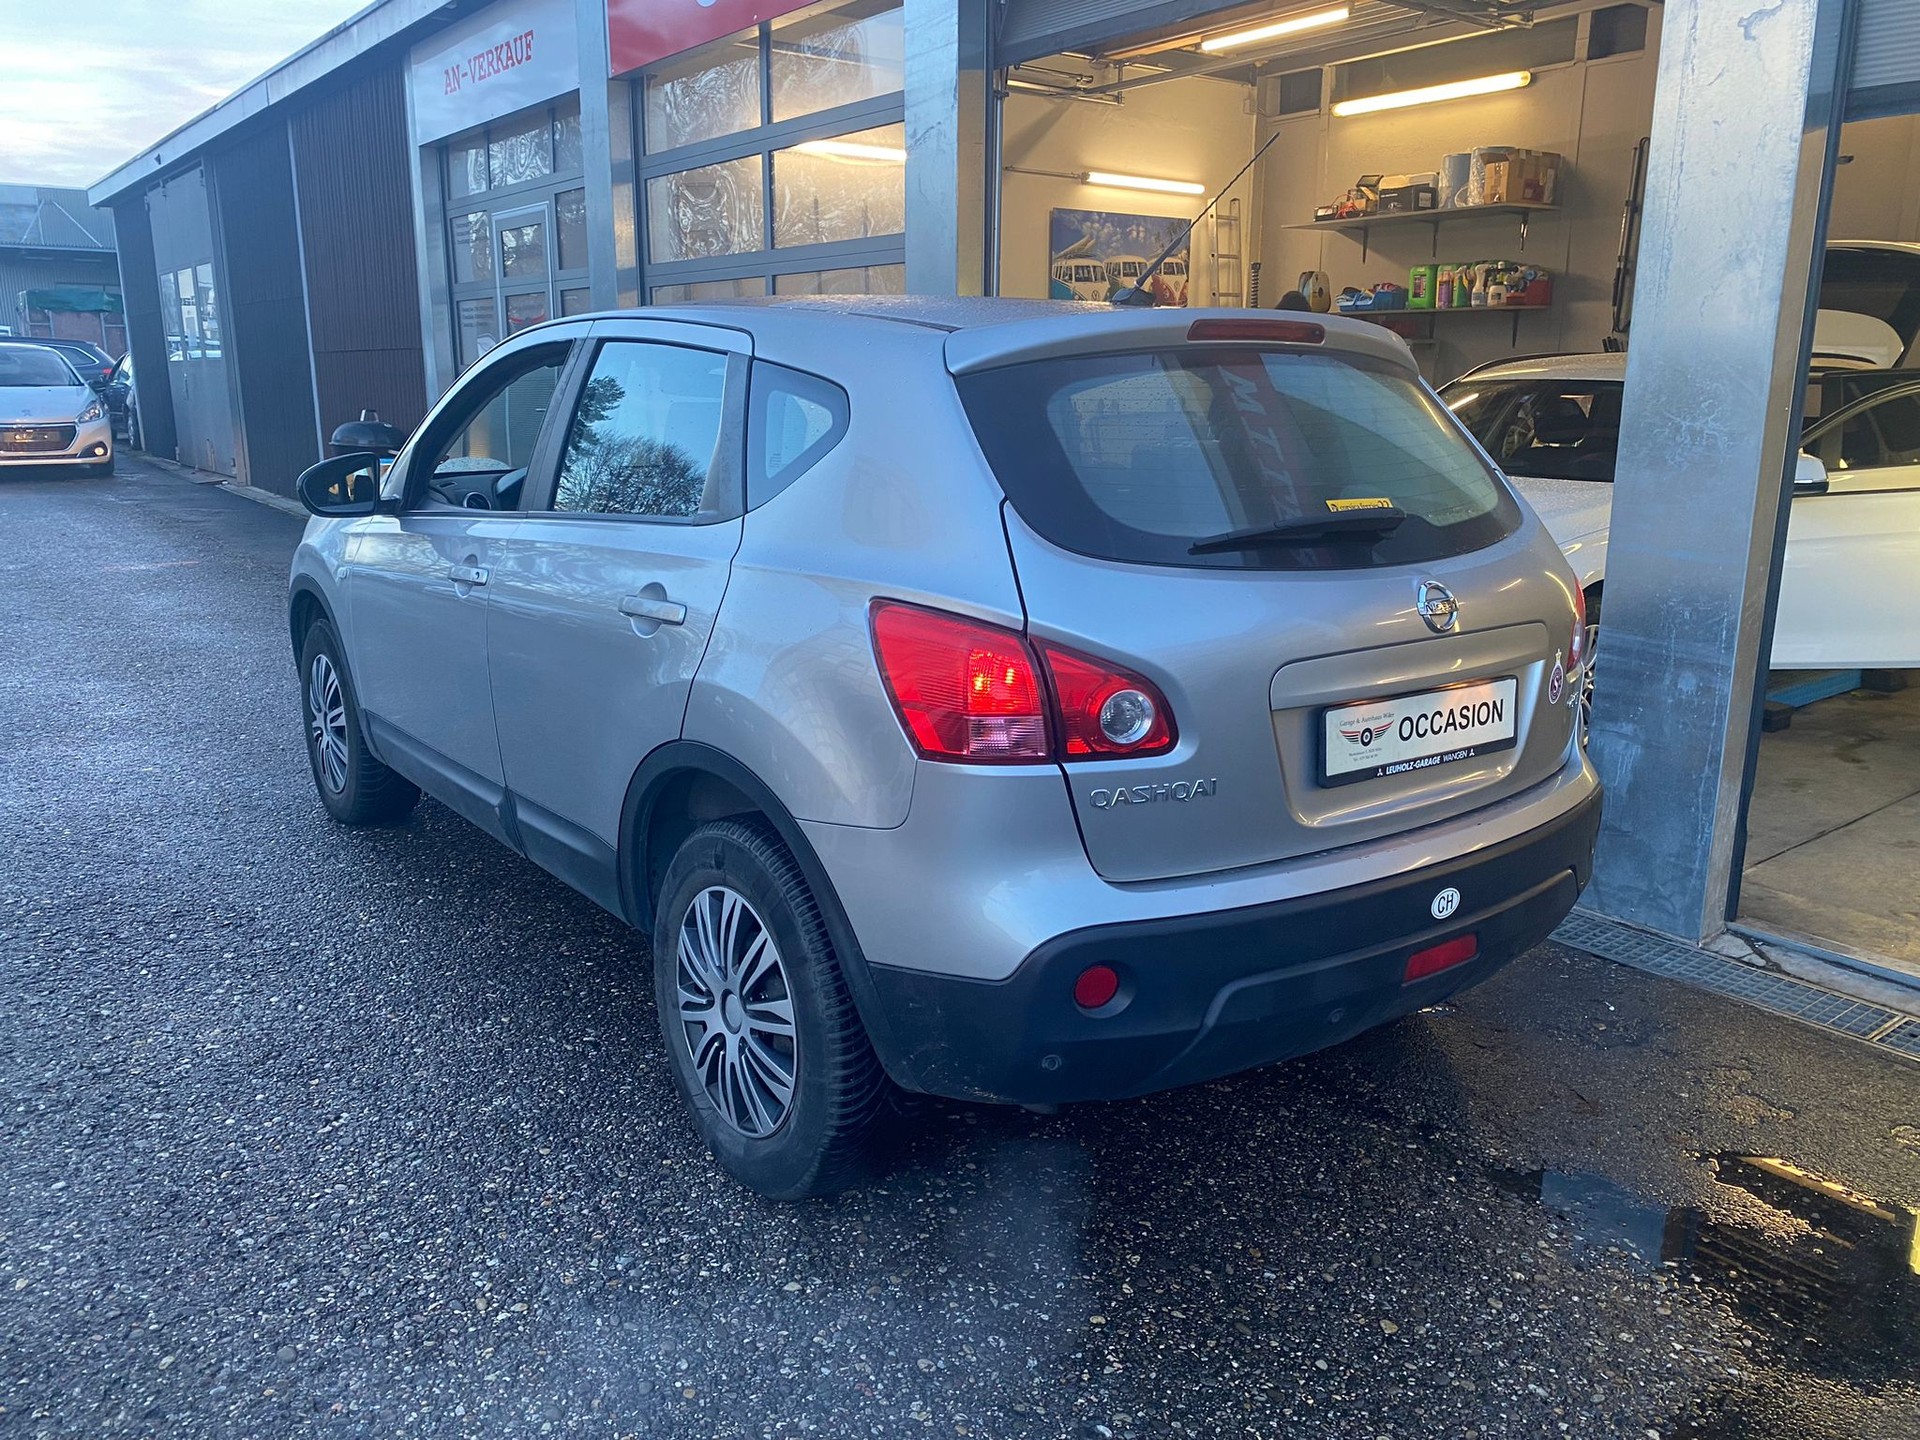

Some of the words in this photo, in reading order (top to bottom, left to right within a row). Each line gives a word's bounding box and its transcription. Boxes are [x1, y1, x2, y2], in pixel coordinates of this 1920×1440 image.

[444, 29, 534, 95] AN-VERKAUF
[1398, 699, 1504, 742] OCCASION
[1386, 756, 1441, 775] LEUHOLZ-GARAGE
[1442, 750, 1468, 763] WANGEN
[1089, 778, 1217, 810] QASHQAI
[1437, 892, 1454, 914] CH
